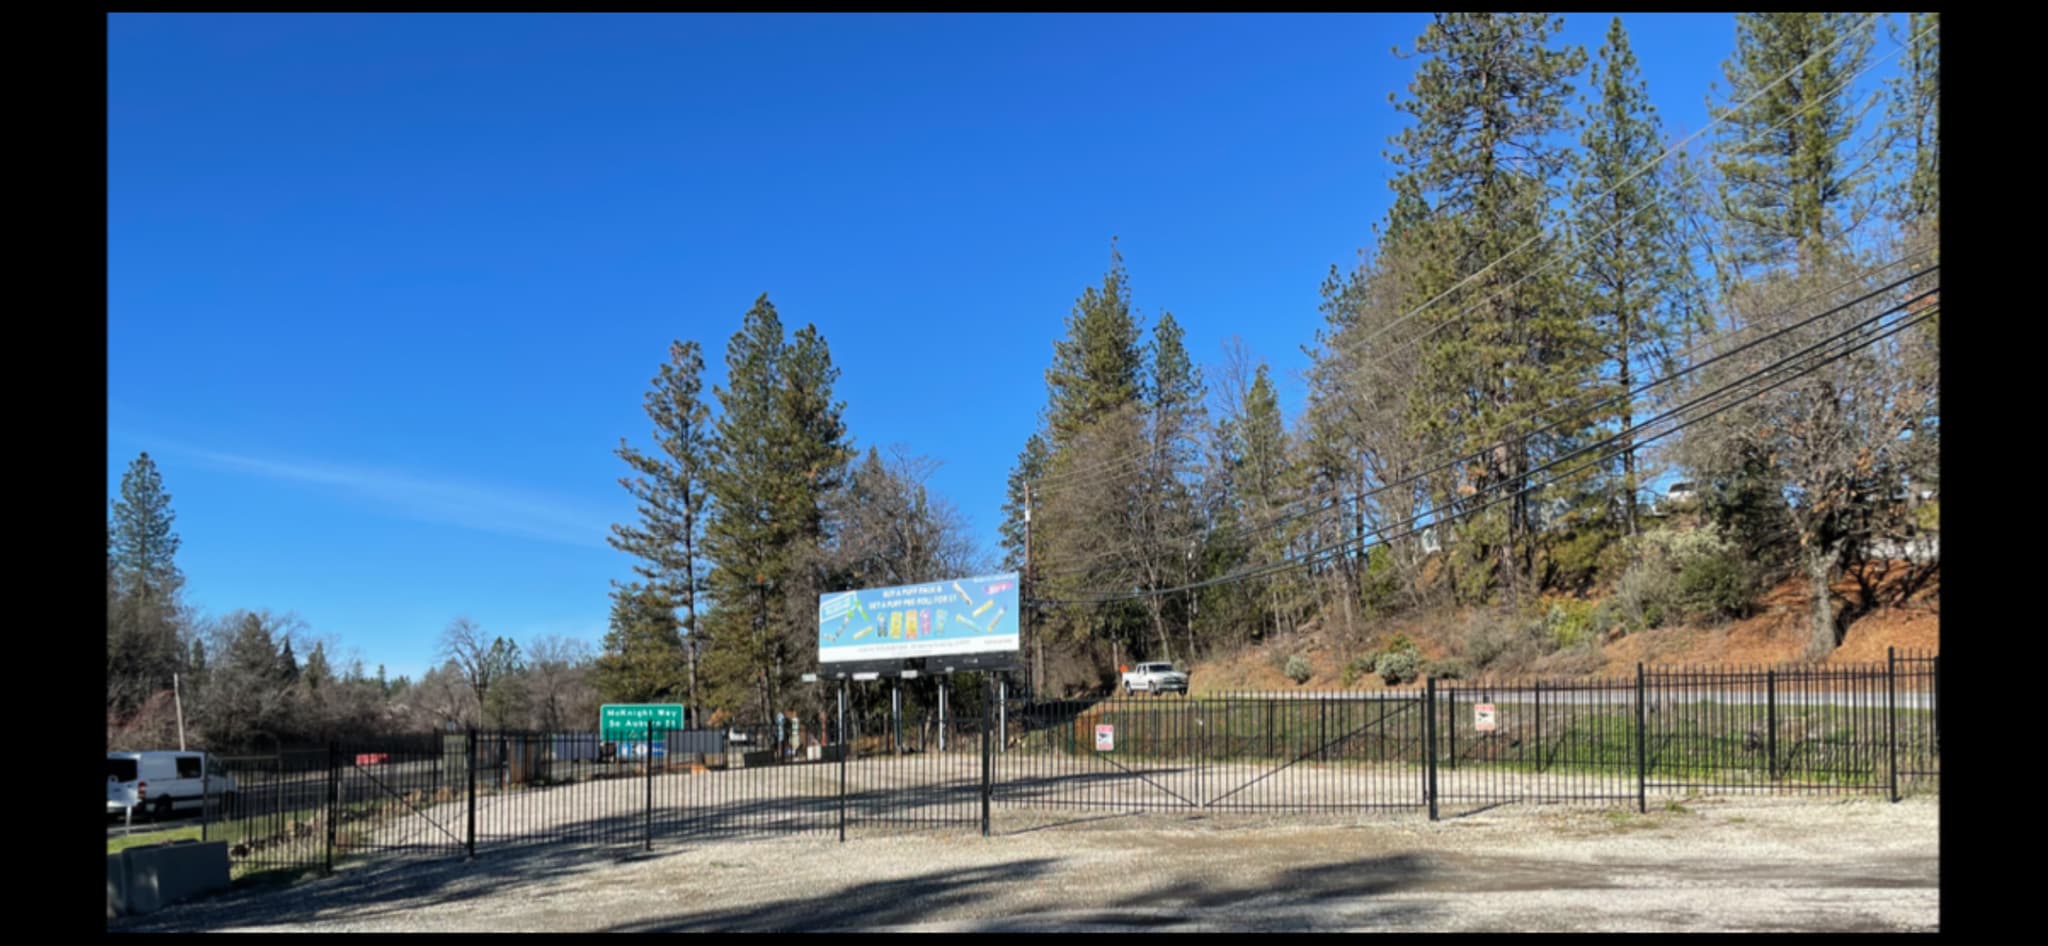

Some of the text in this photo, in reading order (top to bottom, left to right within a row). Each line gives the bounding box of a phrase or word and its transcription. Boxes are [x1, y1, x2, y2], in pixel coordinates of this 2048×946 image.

[607, 709, 678, 718] McKnight Way
[609, 720, 676, 728] So Auburn St
